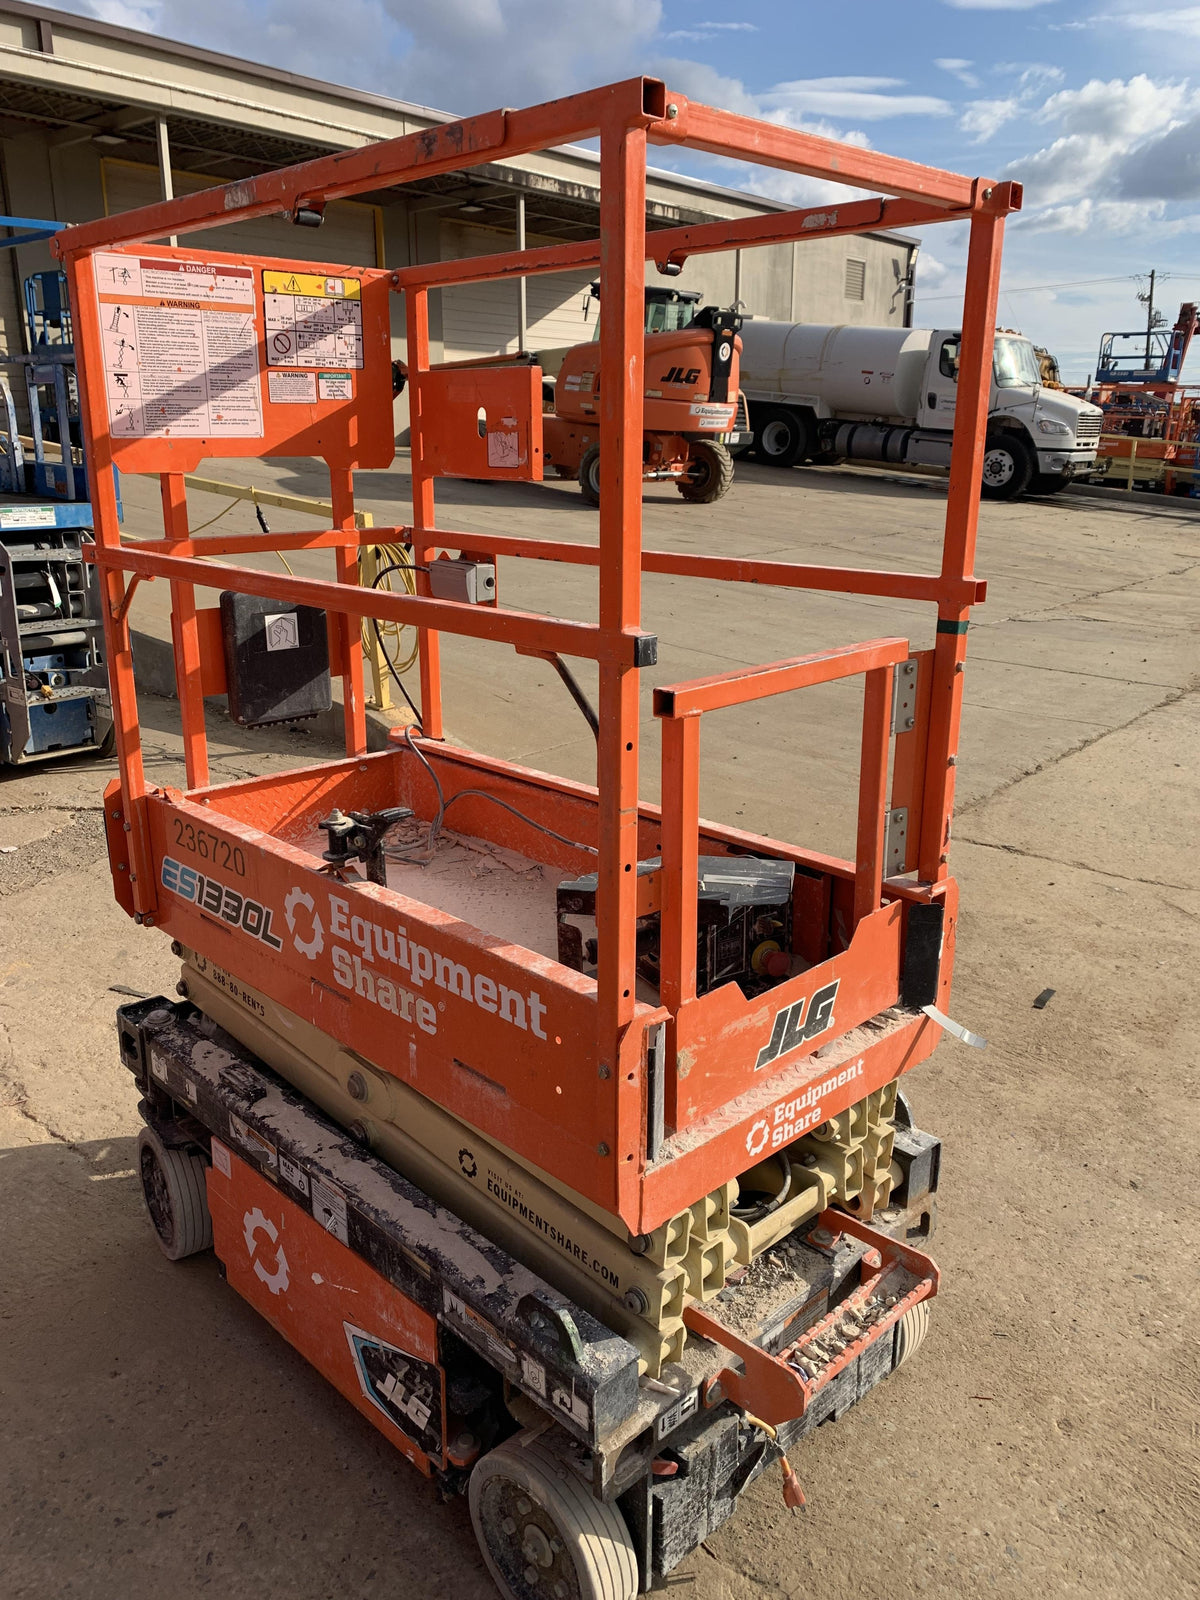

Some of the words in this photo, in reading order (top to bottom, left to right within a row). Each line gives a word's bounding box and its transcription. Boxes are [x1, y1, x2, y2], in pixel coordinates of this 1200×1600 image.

[186, 265, 217, 275] DANGER
[166, 300, 201, 309] WARNING
[660, 366, 702, 385] JLG
[174, 818, 245, 876] 236720
[162, 856, 283, 951] ES1330L
[328, 893, 548, 1041] Equipment
[331, 945, 437, 1036] Share
[754, 978, 841, 1072] JLG
[773, 1058, 864, 1126] Equipment
[771, 1106, 822, 1148] Share
[487, 1178, 620, 1289] EQUIPMENTSHARE.COM
[376, 1372, 432, 1431] JLG
